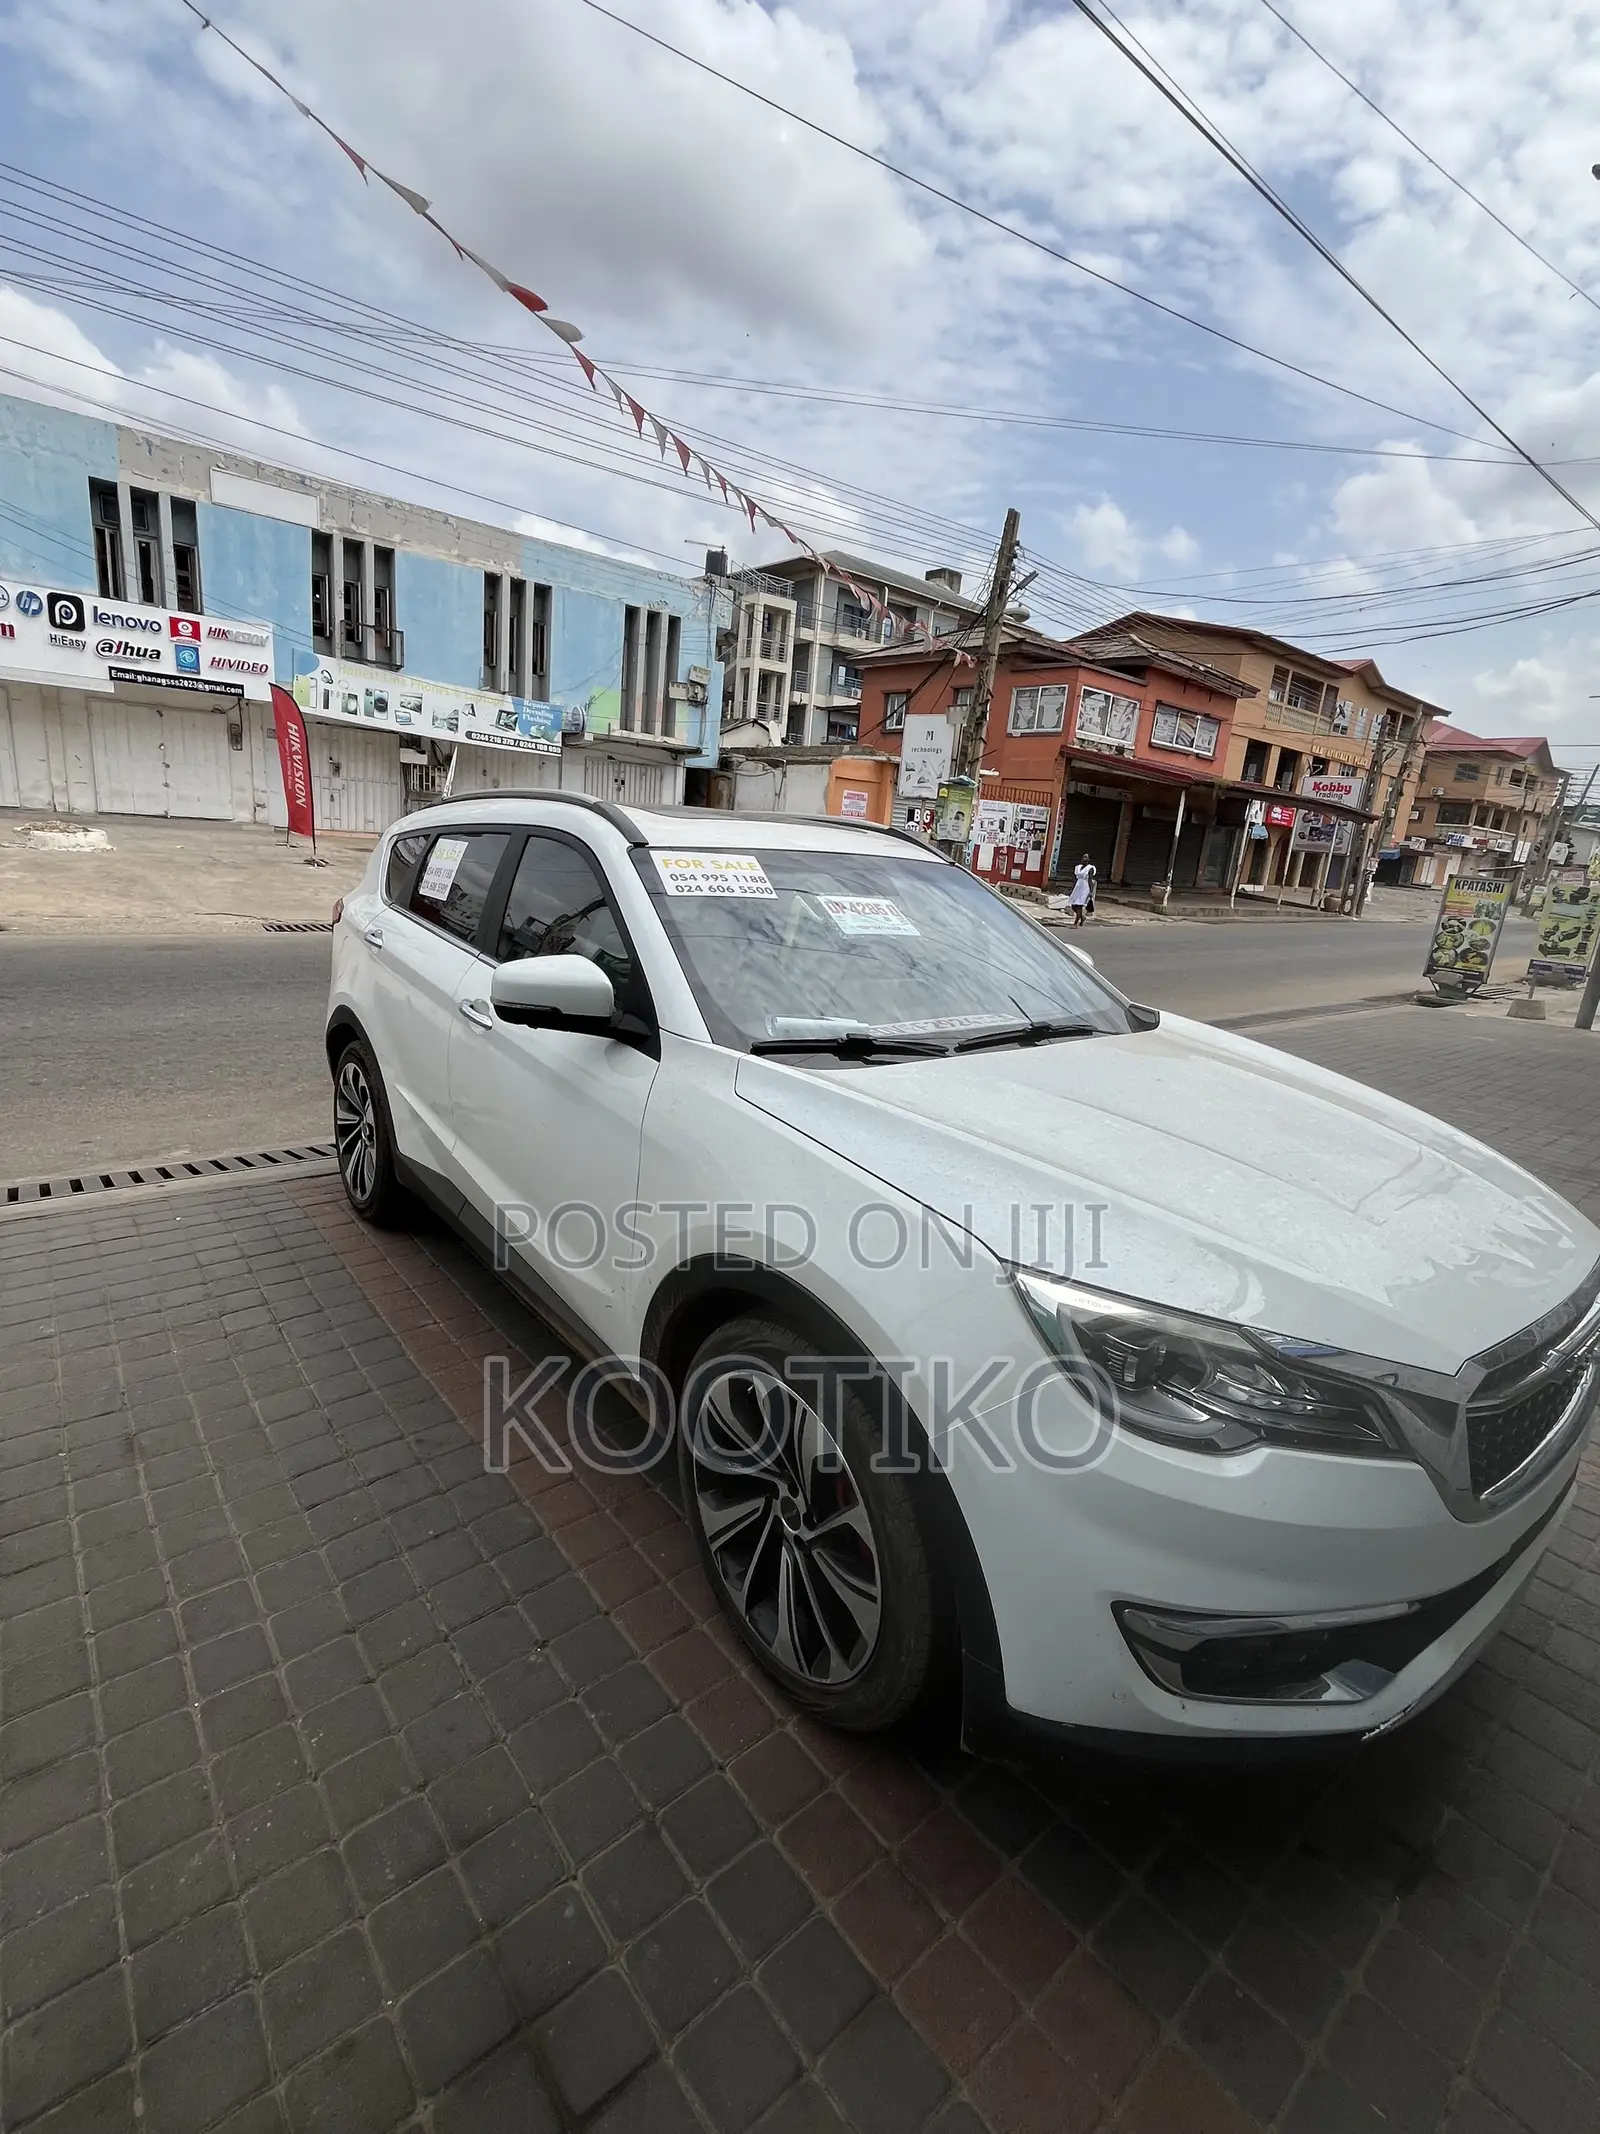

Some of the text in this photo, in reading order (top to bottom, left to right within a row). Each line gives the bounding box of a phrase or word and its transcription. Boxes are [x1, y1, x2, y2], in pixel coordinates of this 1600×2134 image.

[93, 606, 162, 632] lenovo
[49, 633, 87, 650] HiEasy
[207, 626, 270, 647] HIKVISION
[210, 656, 269, 674] HIVIDEO
[287, 721, 307, 808] HIKVISION
[1312, 781, 1353, 795] Kobby
[1315, 791, 1344, 800] Trading
[914, 808, 931, 823] BG
[662, 858, 761, 871] FOR SALE
[670, 873, 768, 884] 054 995 1188
[675, 884, 773, 895] 024 606 5500
[1454, 879, 1505, 894] KPATASHI
